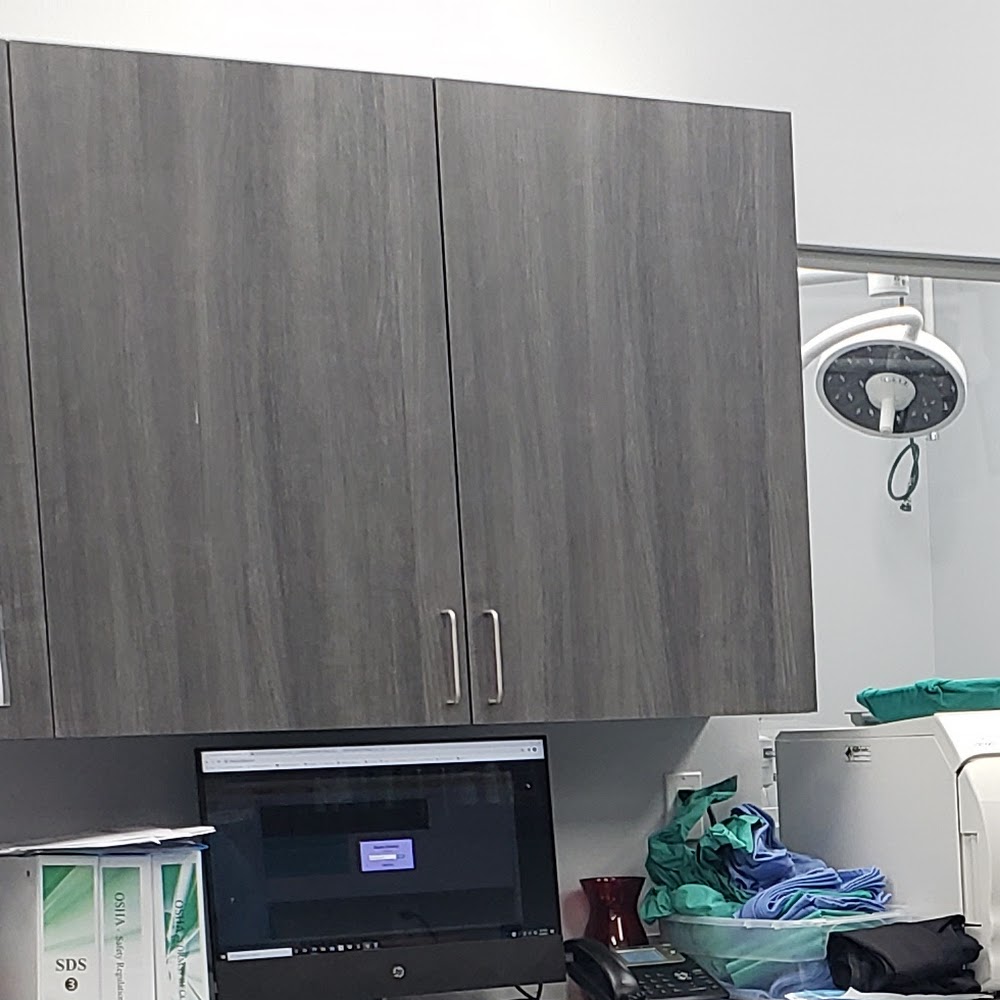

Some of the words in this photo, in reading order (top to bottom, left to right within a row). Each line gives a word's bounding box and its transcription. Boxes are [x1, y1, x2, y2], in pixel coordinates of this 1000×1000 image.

[114, 892, 126, 926] OSHA
[174, 899, 186, 932] OSHA
[114, 935, 124, 960] Safety
[55, 957, 87, 972] SDS
[66, 978, 78, 990] 3
